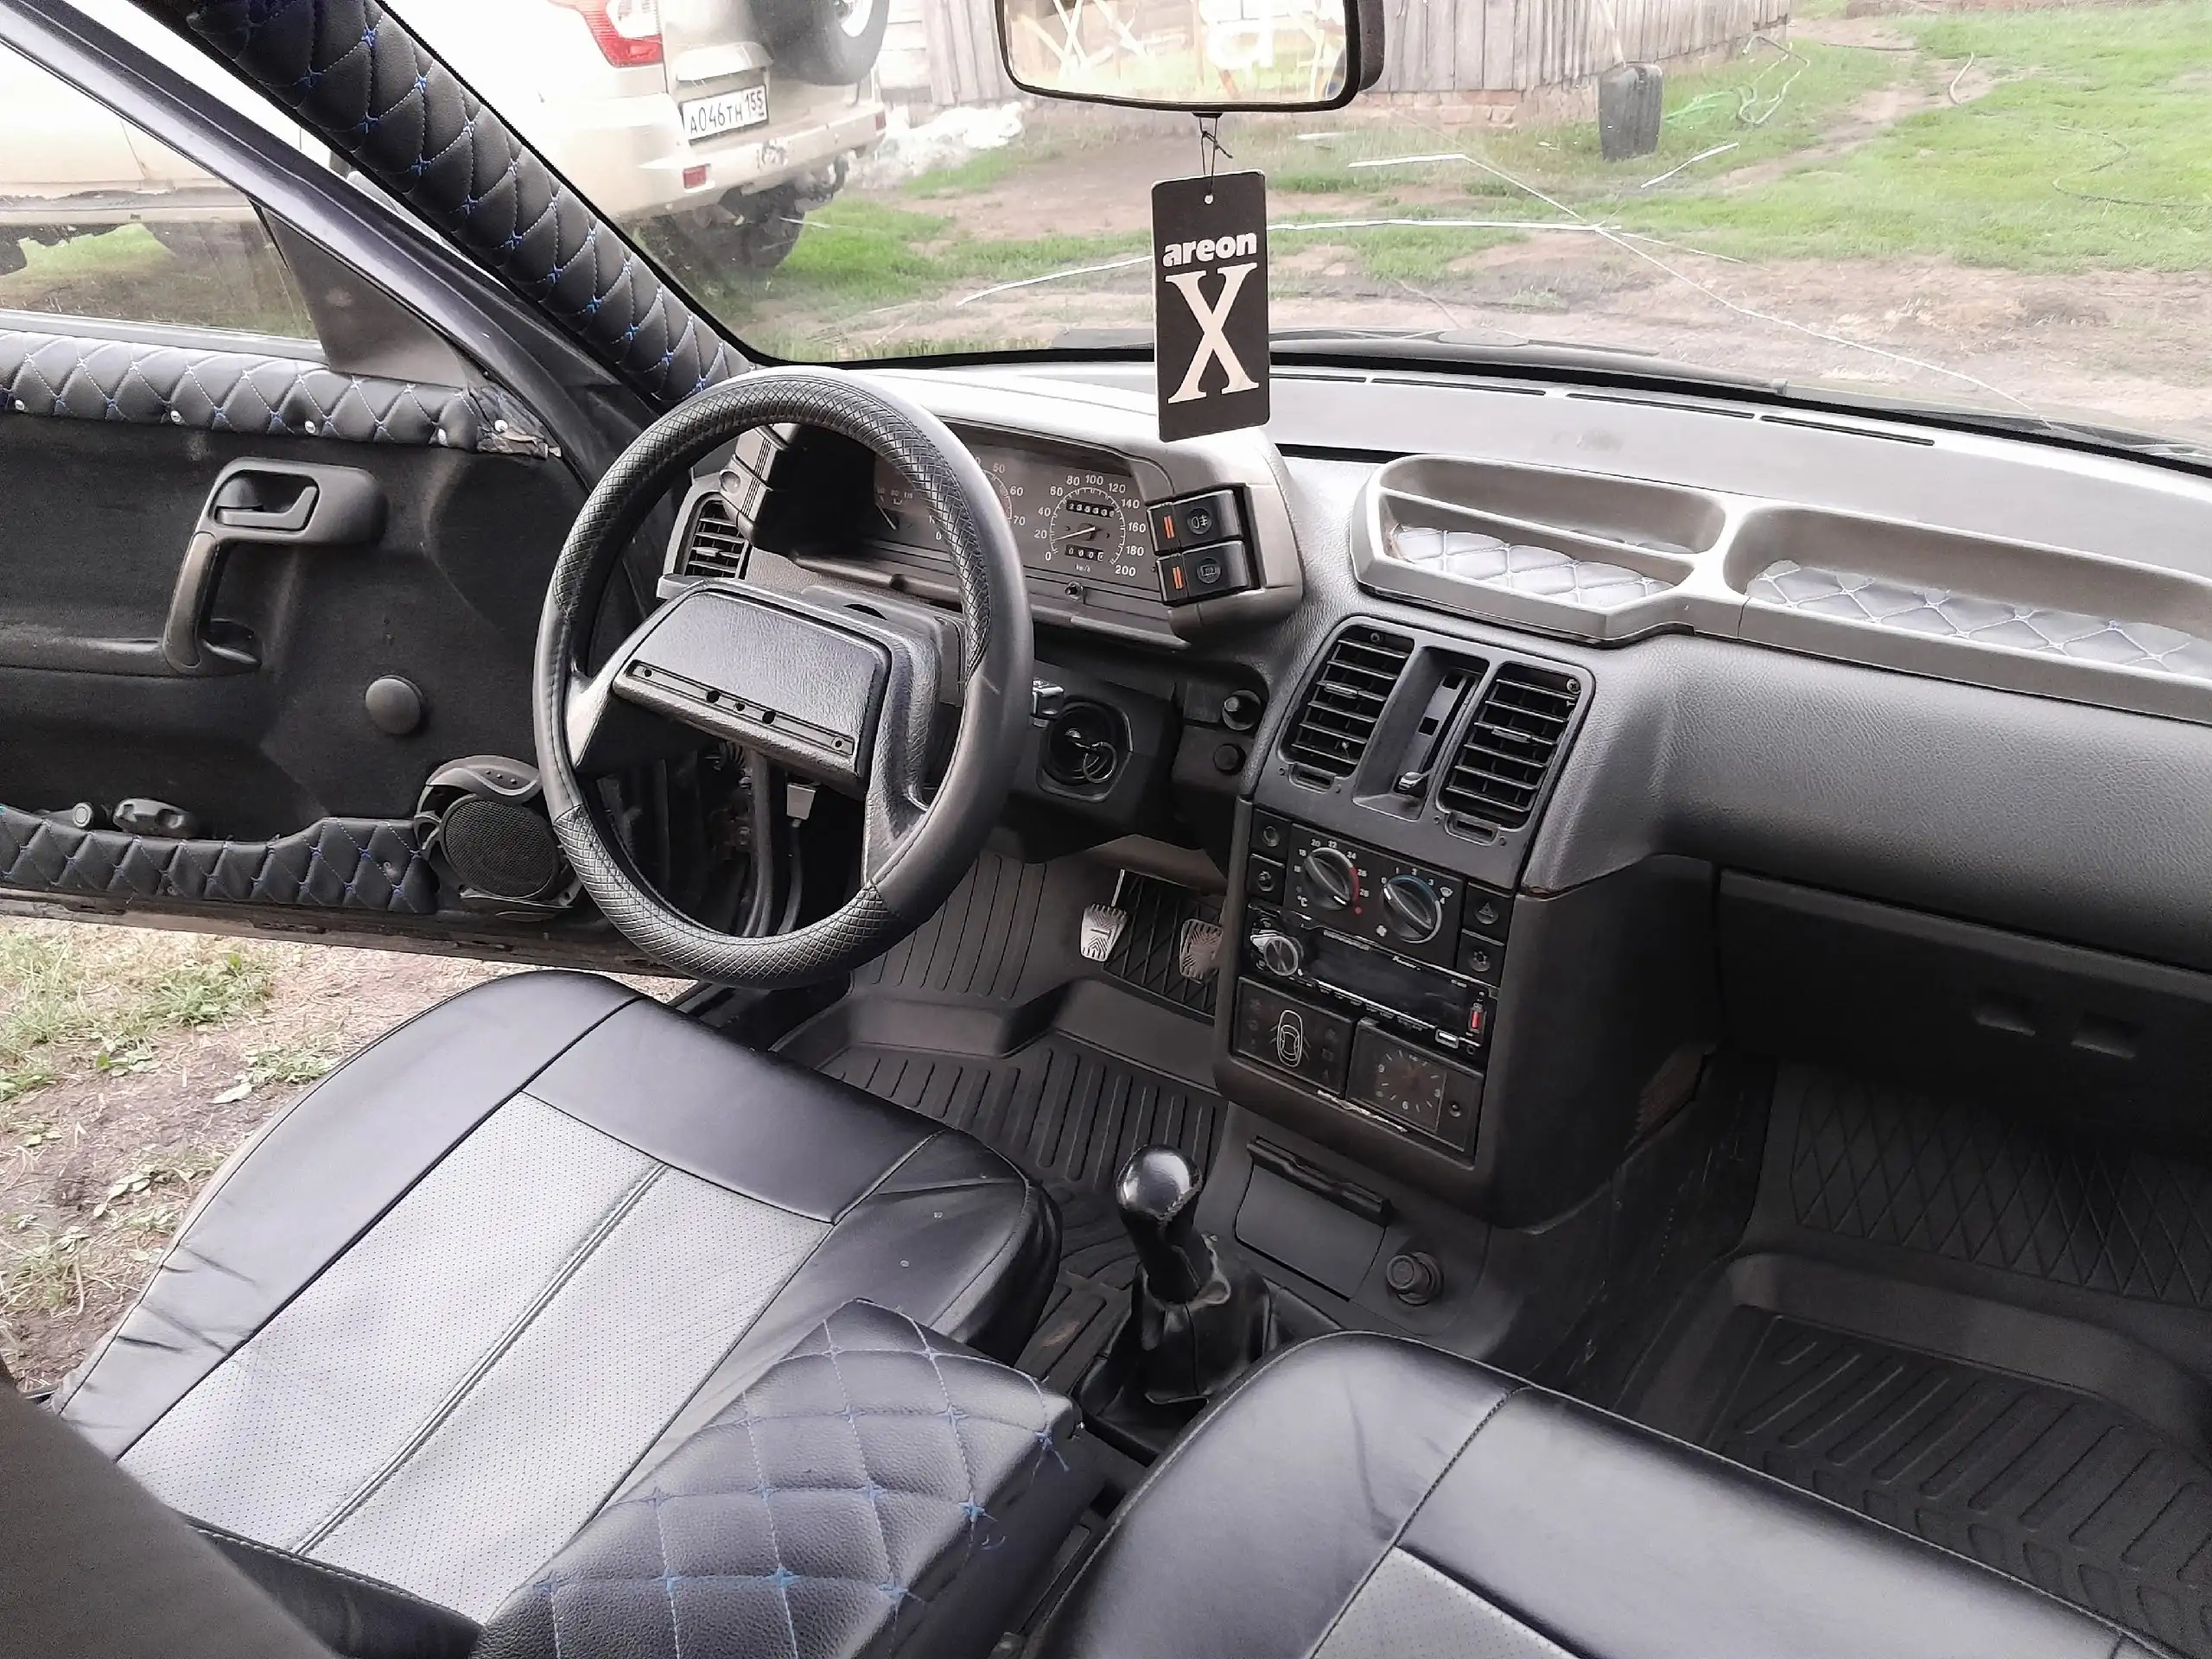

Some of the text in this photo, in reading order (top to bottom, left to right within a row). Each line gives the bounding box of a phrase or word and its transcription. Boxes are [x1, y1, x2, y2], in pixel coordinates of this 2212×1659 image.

[745, 89, 764, 118] 155
[1162, 232, 1257, 267] areon
[1165, 262, 1260, 404] X
[1066, 475, 1080, 486] 80
[1085, 474, 1104, 486] 100
[1010, 486, 1024, 497] 60
[1050, 486, 1064, 497] 60
[1109, 483, 1126, 494] 120
[1122, 499, 1140, 509] 140
[1038, 506, 1052, 517] 40
[1014, 516, 1026, 526] 70
[1128, 522, 1147, 533] 160
[936, 531, 942, 540] 0
[1034, 530, 1047, 539] 20
[1045, 551, 1052, 561] 0
[1126, 545, 1145, 556] 180
[1115, 564, 1136, 577] 200
[1402, 1100, 1408, 1110] 6
